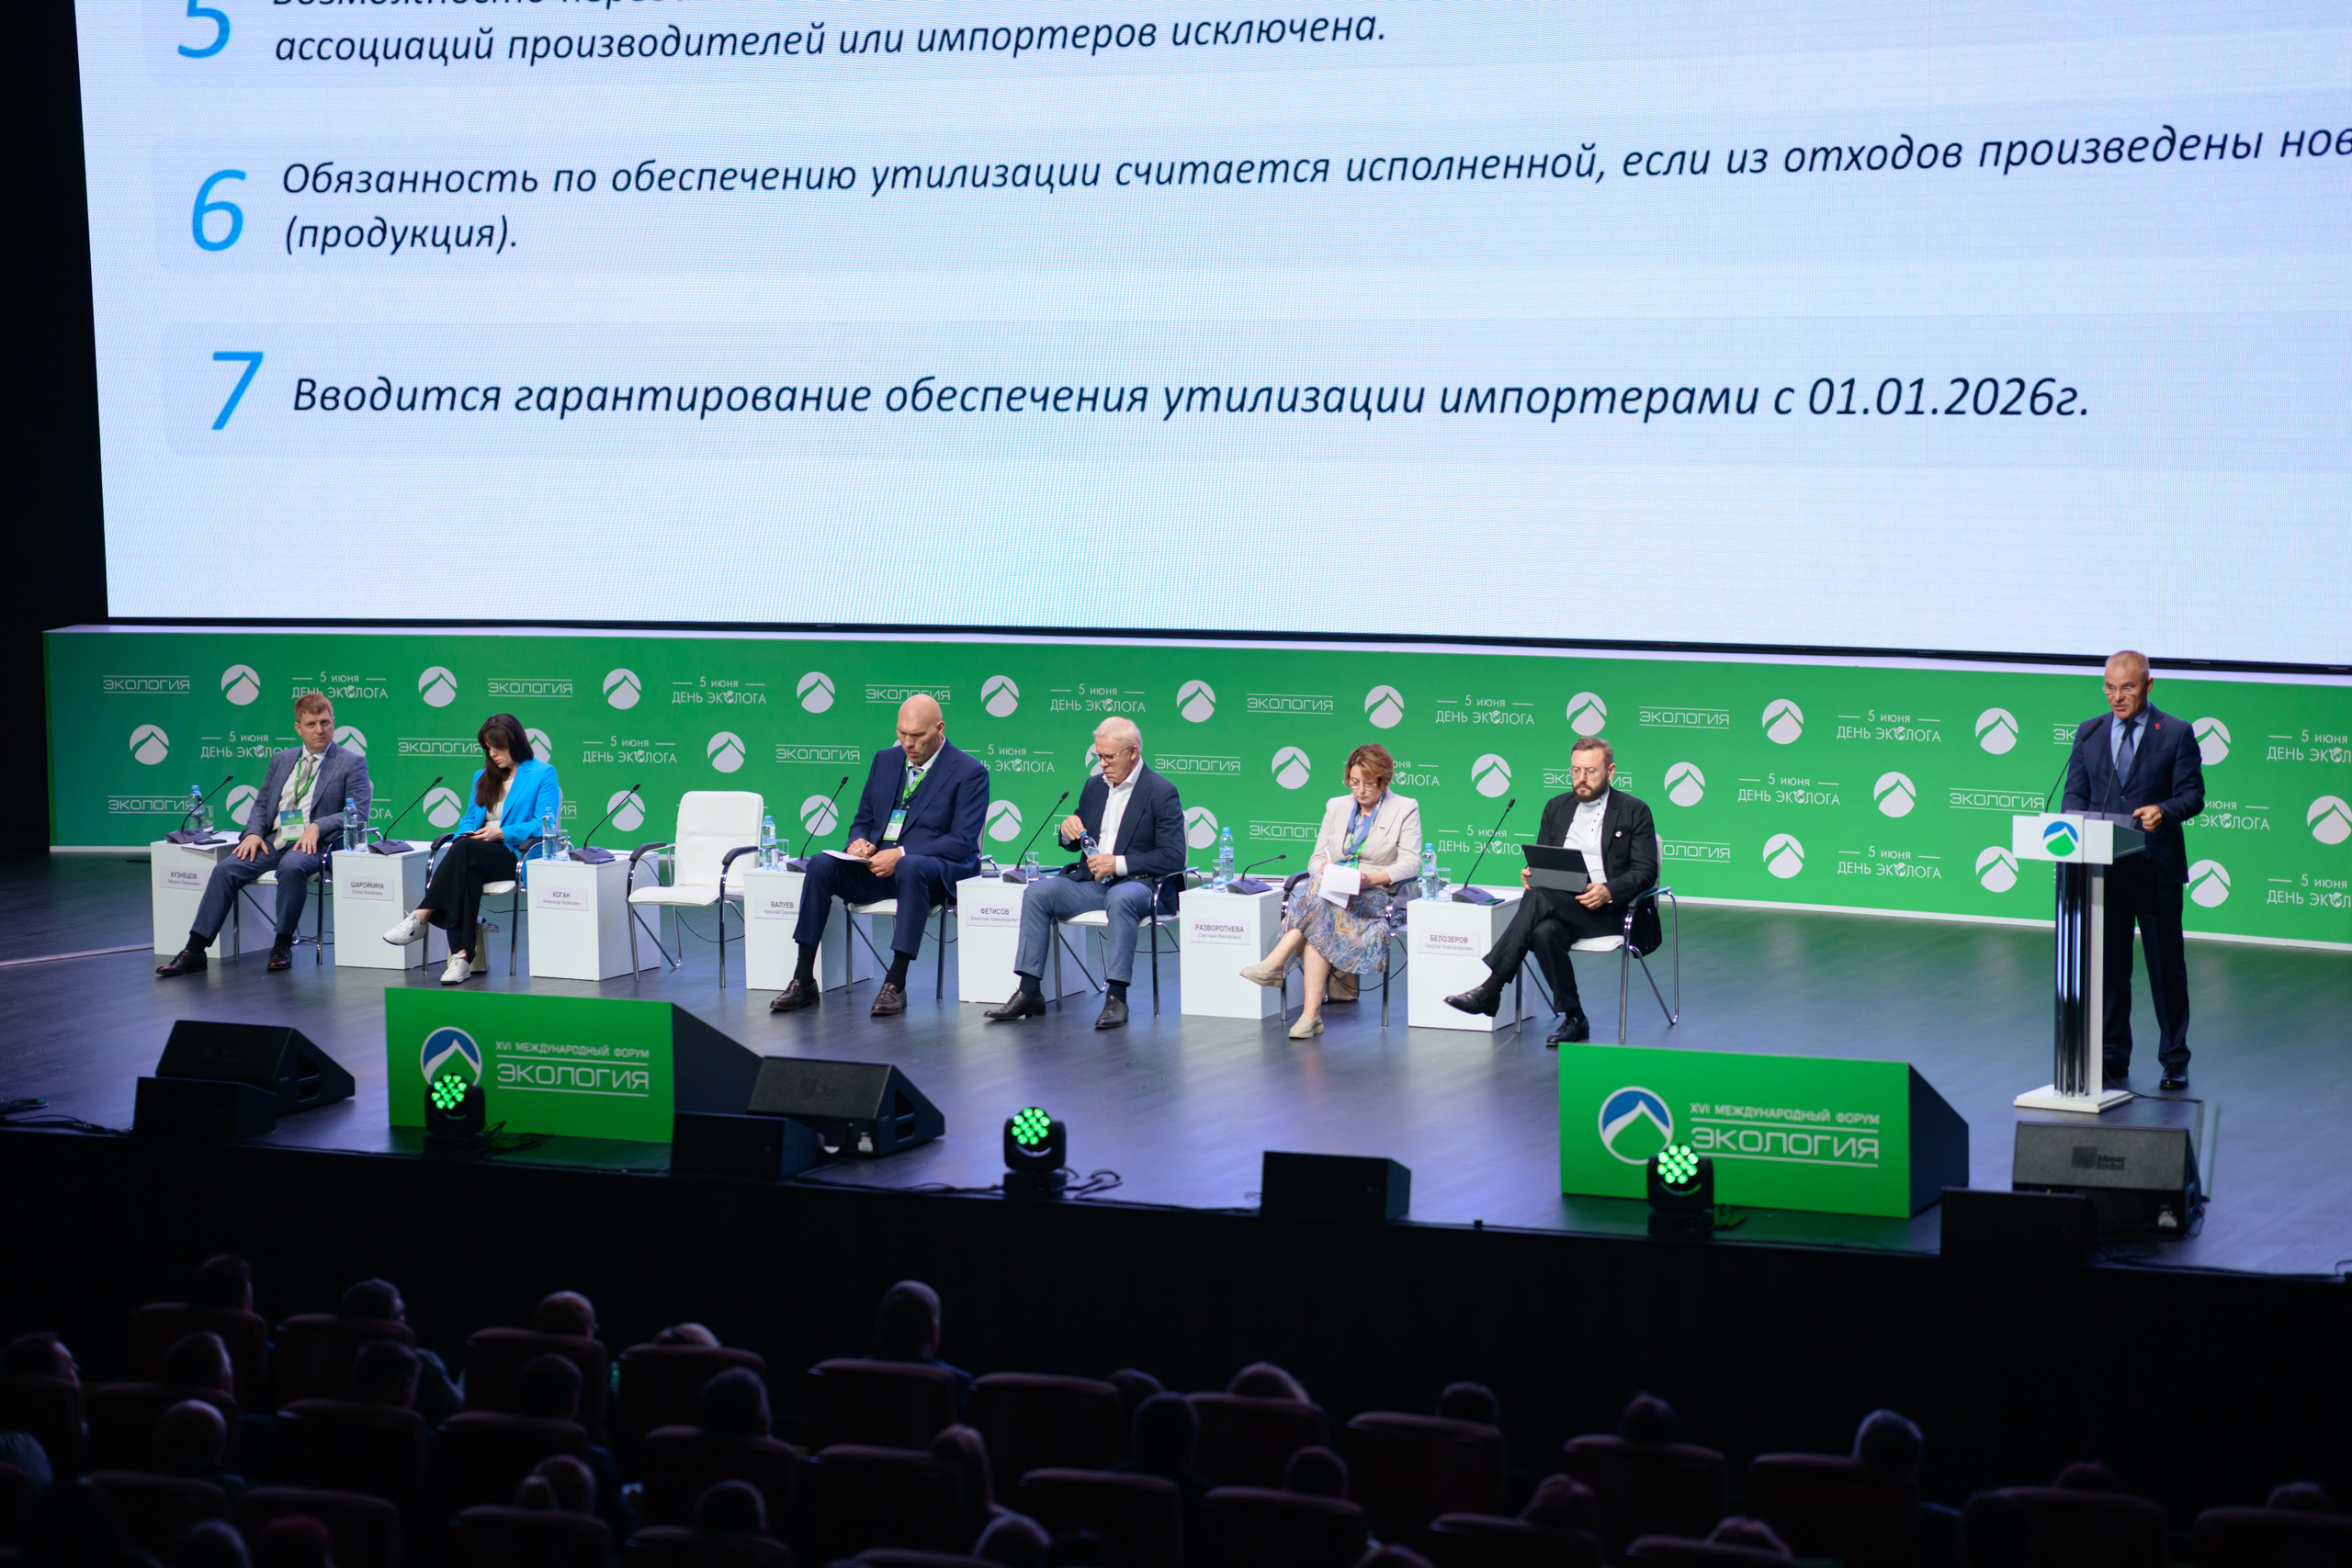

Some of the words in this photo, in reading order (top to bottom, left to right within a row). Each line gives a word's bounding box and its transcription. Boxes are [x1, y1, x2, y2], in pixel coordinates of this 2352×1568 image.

[178, 0, 231, 59] 5
[276, 28, 493, 66] ассоциаций
[509, 22, 824, 66] производителей
[840, 30, 903, 53] или
[918, 23, 1156, 58] импортеров
[1172, 17, 1386, 46] исключена.
[284, 162, 537, 193] Обязанность
[554, 169, 596, 192] по
[613, 160, 855, 191] обеспечению
[872, 164, 1100, 197] утилизации
[1116, 159, 1329, 186] считается
[1347, 143, 1604, 184] исполненной,
[1623, 150, 1710, 176] если
[1727, 149, 1768, 174] из
[1785, 134, 1962, 172] отходов
[1980, 125, 2263, 175] произведены
[192, 170, 246, 251] 6
[287, 215, 517, 255] (продукция).
[212, 351, 264, 430] 7
[294, 376, 501, 411] Вводится
[514, 386, 871, 420] гарантирование
[886, 376, 1148, 412] обеспечения
[1163, 387, 1425, 421] утилизации
[1441, 388, 1758, 423] импортерами
[1775, 388, 1794, 414] с
[1810, 378, 2086, 415] 01.01.2026г.
[320, 671, 327, 682] 5
[332, 674, 359, 683] июня
[699, 676, 707, 688] 5
[711, 680, 738, 689] июня
[103, 679, 189, 691] ЭКОЛОГИЯ
[488, 682, 572, 694] ЭКОЛОГИЯ
[1079, 683, 1085, 695] 5
[1090, 687, 1117, 696] июня
[672, 691, 703, 705] ДЕНЬ
[1247, 698, 1333, 711] ЭКОЛОГИЯ
[1464, 695, 1472, 706] 5
[1476, 698, 1505, 707] июня
[1050, 699, 1081, 712] ДЕНЬ
[1436, 710, 1468, 724] ДЕНЬ
[1639, 711, 1729, 725] ЭКОЛОГИЯ
[1868, 710, 1875, 723] 5
[1881, 713, 1911, 723] июня
[229, 731, 236, 742] 5
[241, 734, 269, 742] июня
[1837, 727, 1871, 740] ДЕНЬ
[2301, 729, 2309, 742] 5
[2314, 734, 2347, 744] июня
[398, 741, 483, 753] ЭКОЛОГИЯ
[610, 737, 617, 748] 5
[622, 739, 649, 748] июня
[201, 746, 232, 760] ДЕНЬ
[237, 745, 290, 759] ЭКОЛО
[582, 751, 614, 763] ДЕНЬ
[775, 749, 860, 761] ЭКОЛОГИЯ
[988, 744, 994, 755] 5
[999, 748, 1026, 756] июня
[2267, 746, 2303, 761] ДЕНЬ
[2309, 747, 2352, 763] ЭКОЛ
[1155, 758, 1240, 772] ЭКОЛОГИЯ
[1768, 773, 1775, 785] 5
[1781, 776, 1810, 786] июня
[1737, 789, 1771, 803] ДЕНЬ
[1950, 792, 2045, 809] ЭКОЛОГИЯ
[2205, 800, 2237, 810] июня
[1250, 825, 1320, 838] ЭКОЛОГИ
[1466, 824, 1474, 836] 5
[1478, 828, 1508, 838] июня
[1438, 840, 1470, 853] ДЕНЬ
[1474, 840, 1524, 854] ЭКОЛО
[1663, 844, 1731, 860] ОЛОГИЯ
[1868, 845, 1875, 858] 5
[1881, 850, 1911, 860] июня
[1838, 862, 1871, 875] ДЕНЬ
[171, 872, 198, 880] КУЗНЕЦОВ
[2301, 874, 2309, 886] 5
[2314, 878, 2347, 889] июня
[350, 881, 384, 889] ШАРОЙКИНА
[2267, 889, 2303, 904] ДЕНЬ
[2309, 890, 2352, 908] ЭКОЛ
[980, 908, 1010, 916] ФЕТИСОВ
[1194, 924, 1245, 932] РАЗВОРОТНЕВА
[1430, 935, 1468, 943] БЕЛОЗЕРОВ
[495, 1042, 512, 1050] XVI
[515, 1042, 610, 1056] МЕЖДУНАРОДНЫЙ
[614, 1048, 650, 1058] ФОРУМ
[496, 1063, 650, 1090] ЭКОЛОГИЯ
[1690, 1102, 1710, 1114] XVI
[1714, 1104, 1830, 1122] МЕЖДУНАРОДНЫЙ
[1836, 1112, 1880, 1125] ФОРУМ
[1690, 1127, 1880, 1160] ЭКОЛОГИЯ
